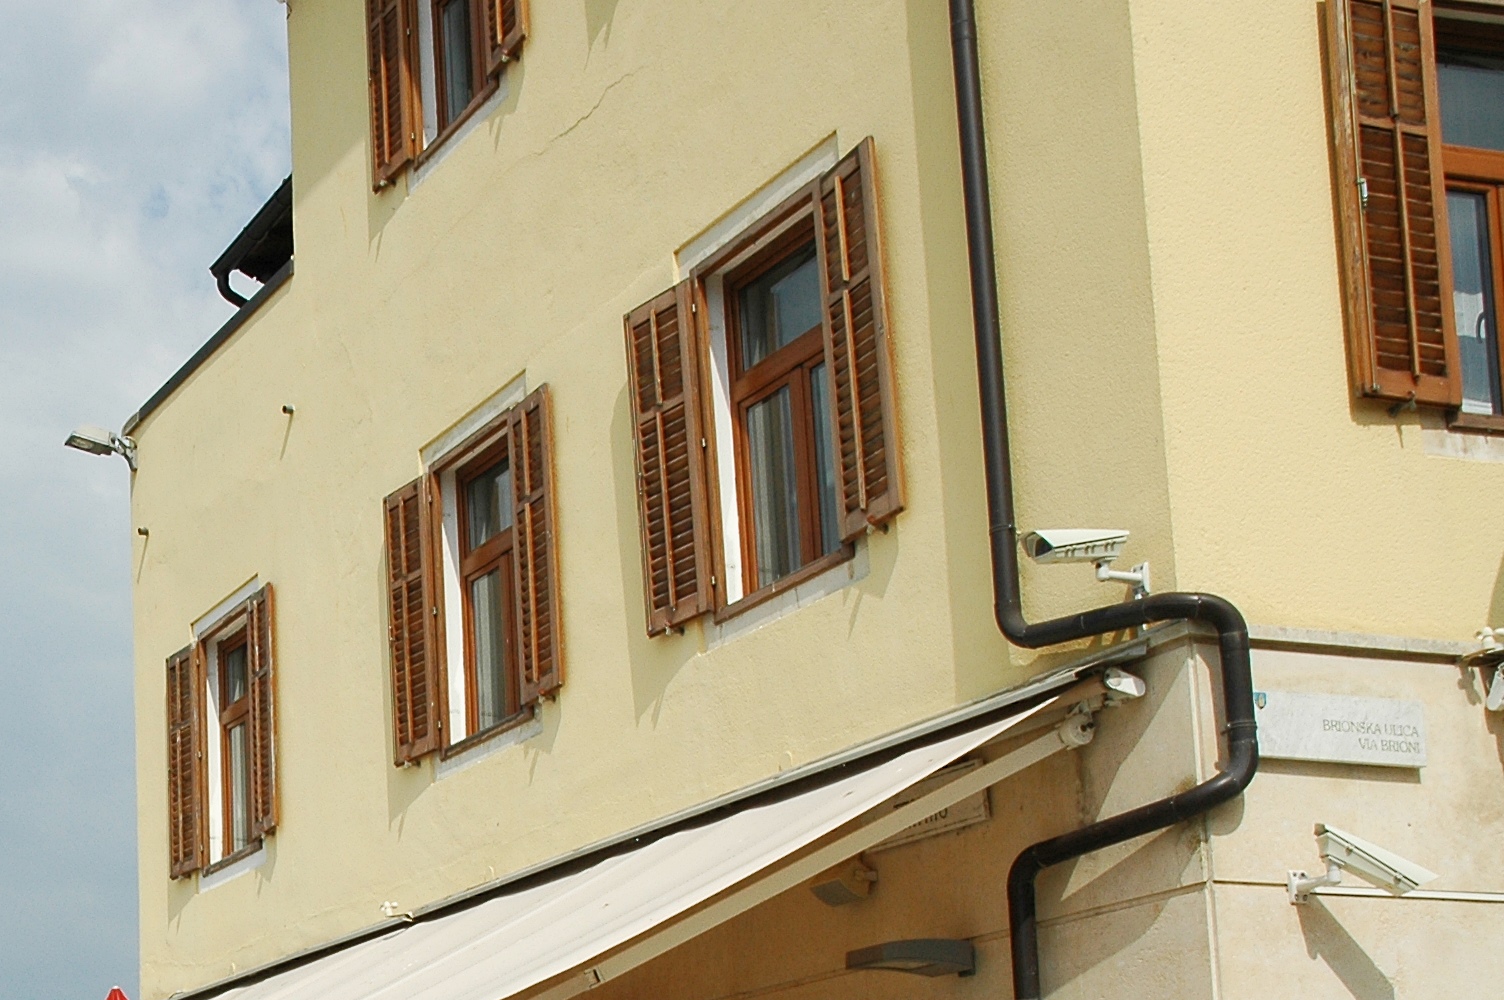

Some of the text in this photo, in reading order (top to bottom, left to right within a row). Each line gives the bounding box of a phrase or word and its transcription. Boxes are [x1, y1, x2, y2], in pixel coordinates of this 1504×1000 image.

[1384, 724, 1419, 738] ULICA
[1358, 737, 1420, 754] VIA BRIONI
